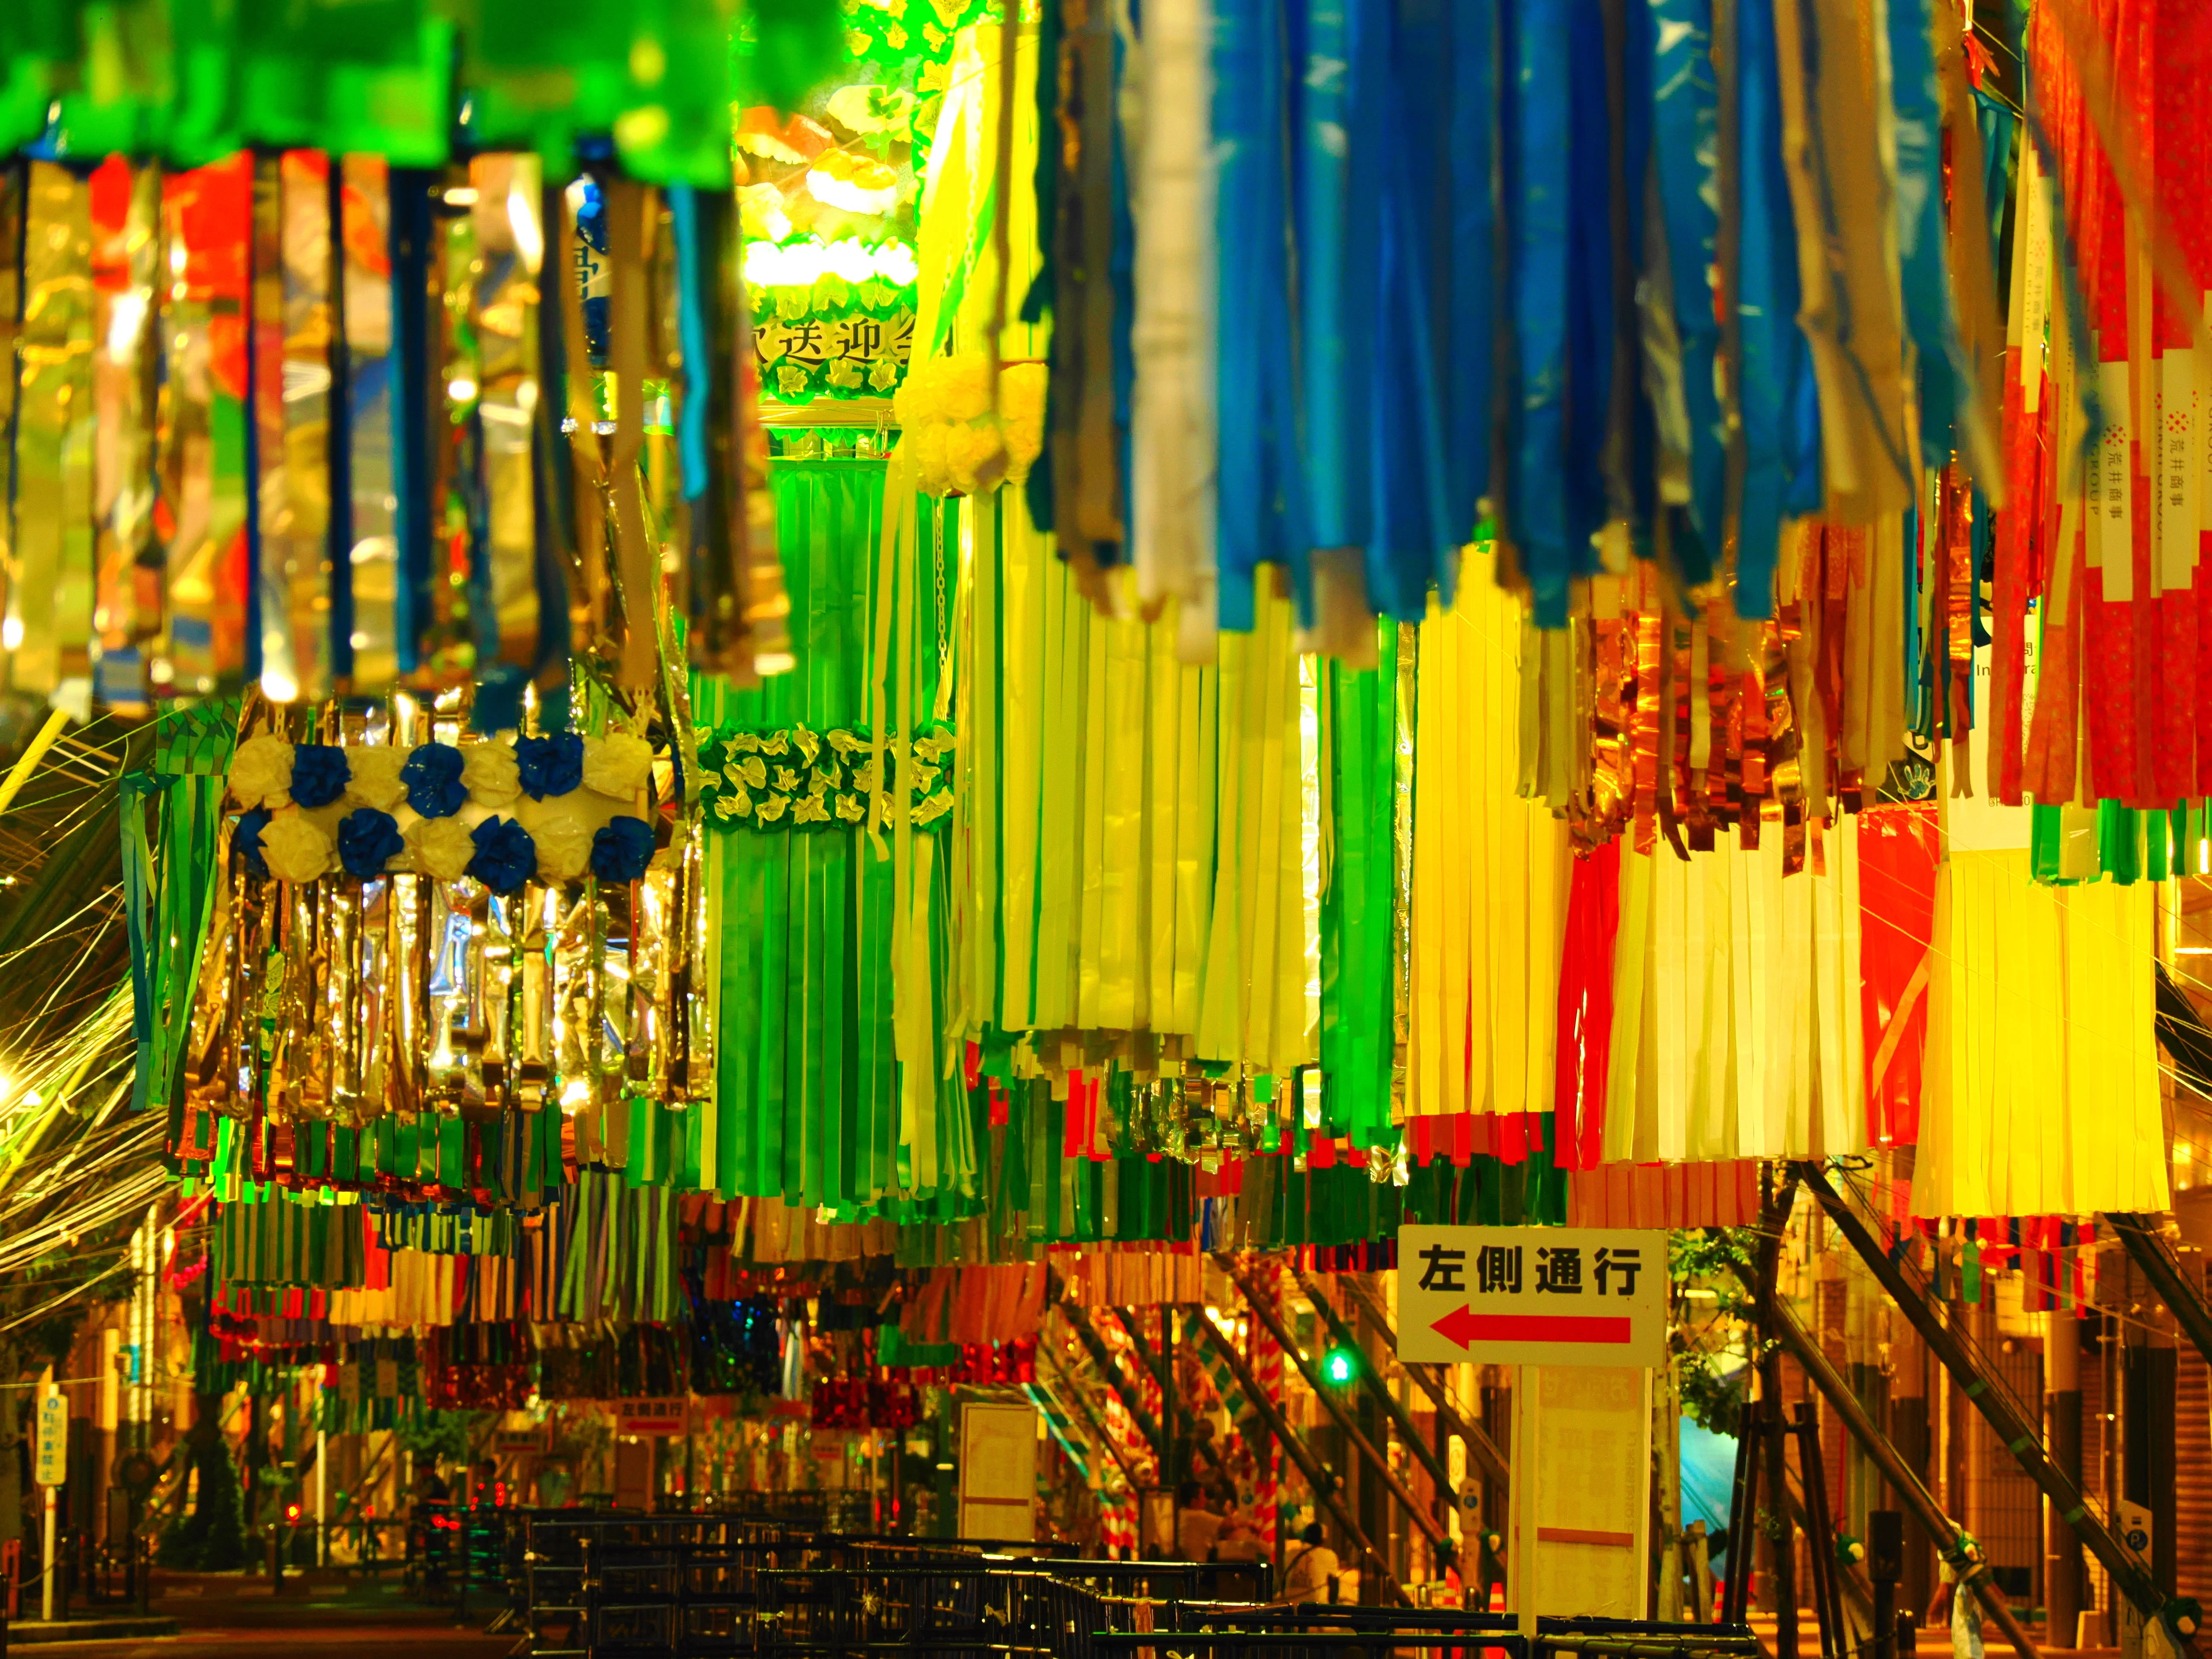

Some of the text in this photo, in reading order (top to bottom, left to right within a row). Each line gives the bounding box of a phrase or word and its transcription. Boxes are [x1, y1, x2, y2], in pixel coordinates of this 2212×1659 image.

[2108, 451, 2123, 520] 荒井商事
[2170, 439, 2185, 507] 荒井商事
[1418, 1244, 1642, 1296] 左側通行
